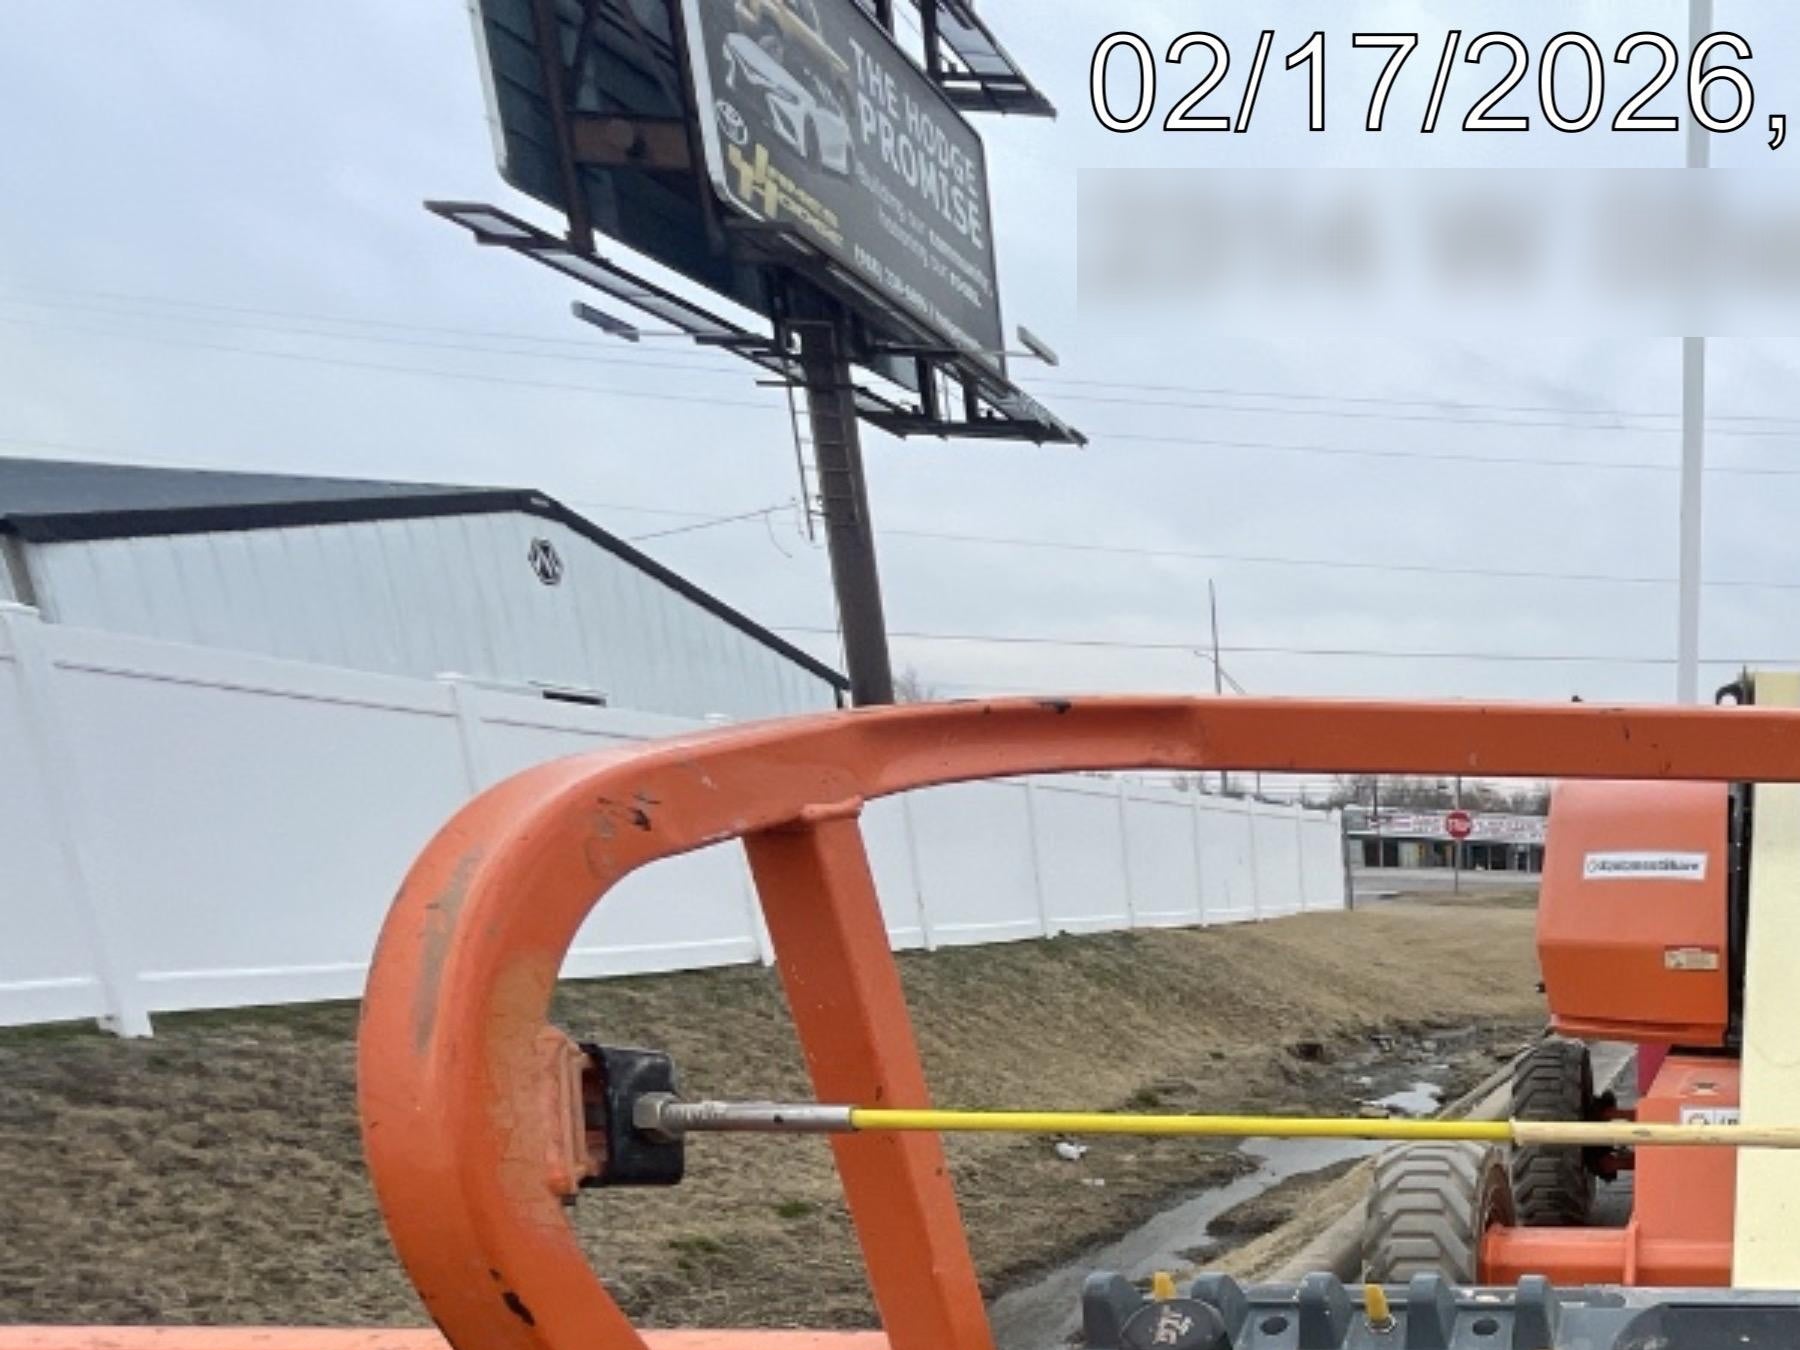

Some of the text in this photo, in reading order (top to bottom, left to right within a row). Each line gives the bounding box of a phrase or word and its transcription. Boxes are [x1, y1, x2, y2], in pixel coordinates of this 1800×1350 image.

[848, 36, 900, 120] THE
[903, 92, 979, 200] HODGE
[856, 91, 985, 251] PROMISE
